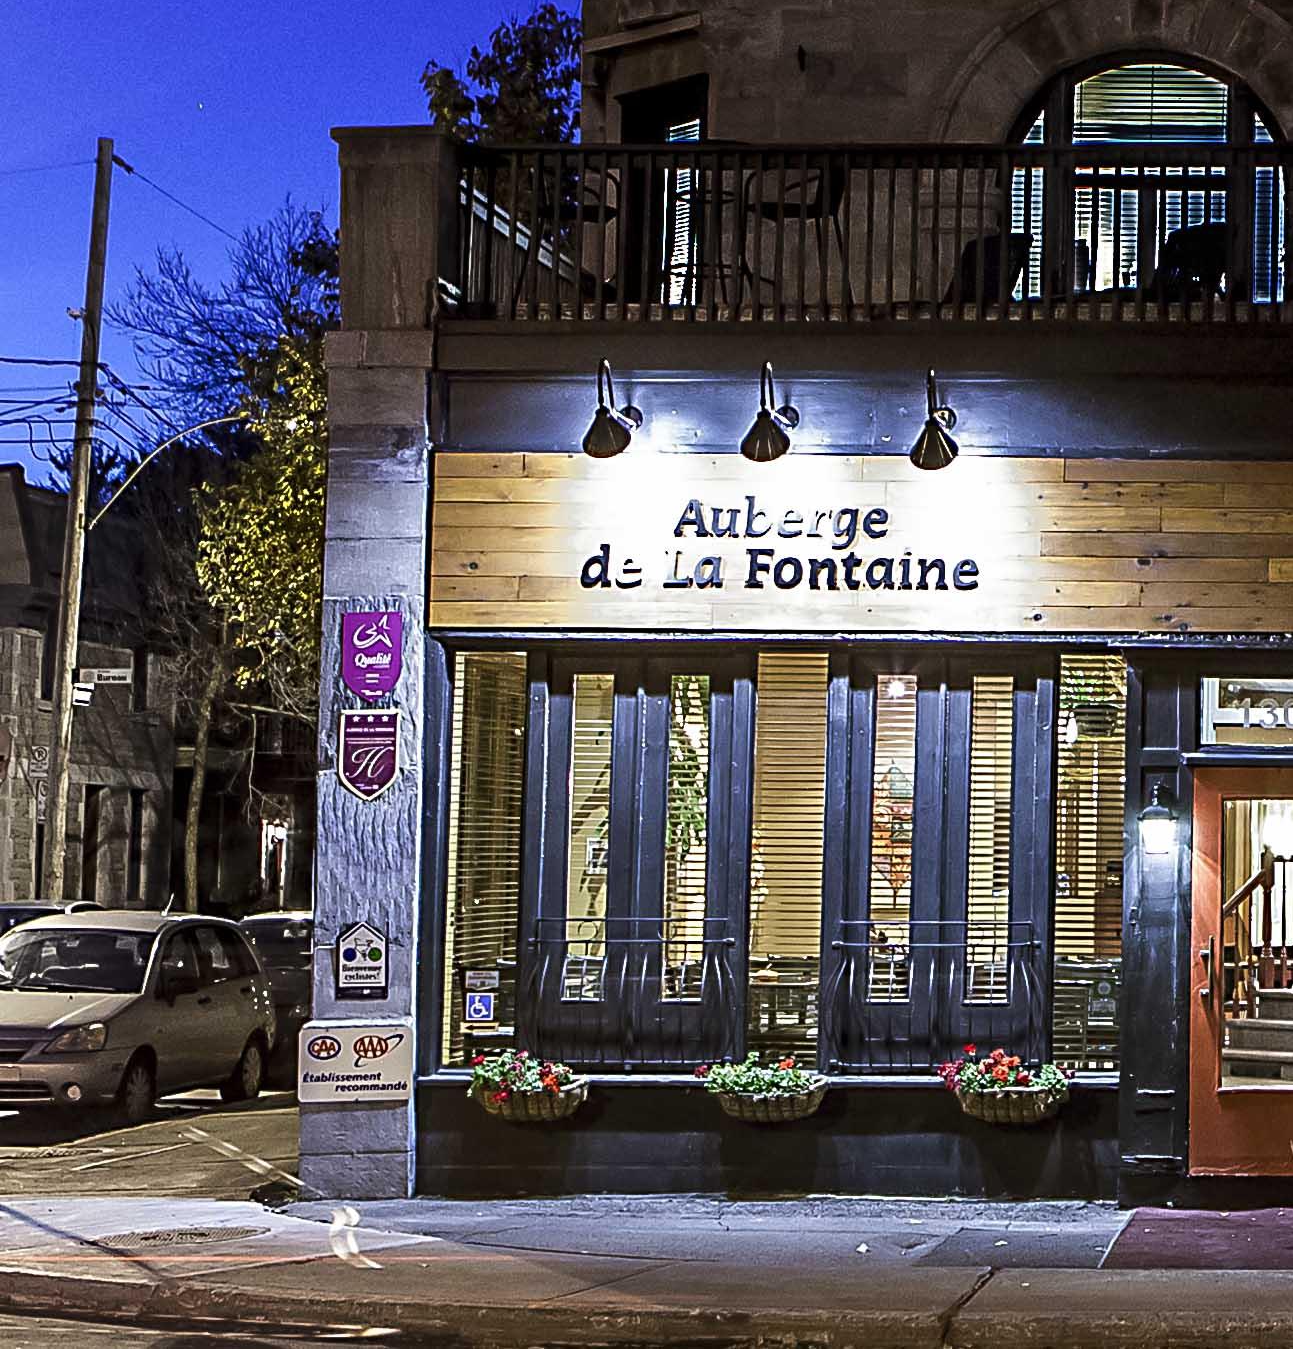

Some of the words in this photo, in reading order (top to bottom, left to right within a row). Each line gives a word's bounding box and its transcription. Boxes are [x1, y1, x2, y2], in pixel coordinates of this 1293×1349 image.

[674, 495, 889, 550] Auberge
[580, 543, 642, 589] de
[662, 550, 724, 589] La
[744, 547, 980, 591] Fontaine
[354, 1036, 388, 1058] AAA
[303, 1072, 381, 1083] Établissement
[335, 1081, 408, 1092] recommandé
